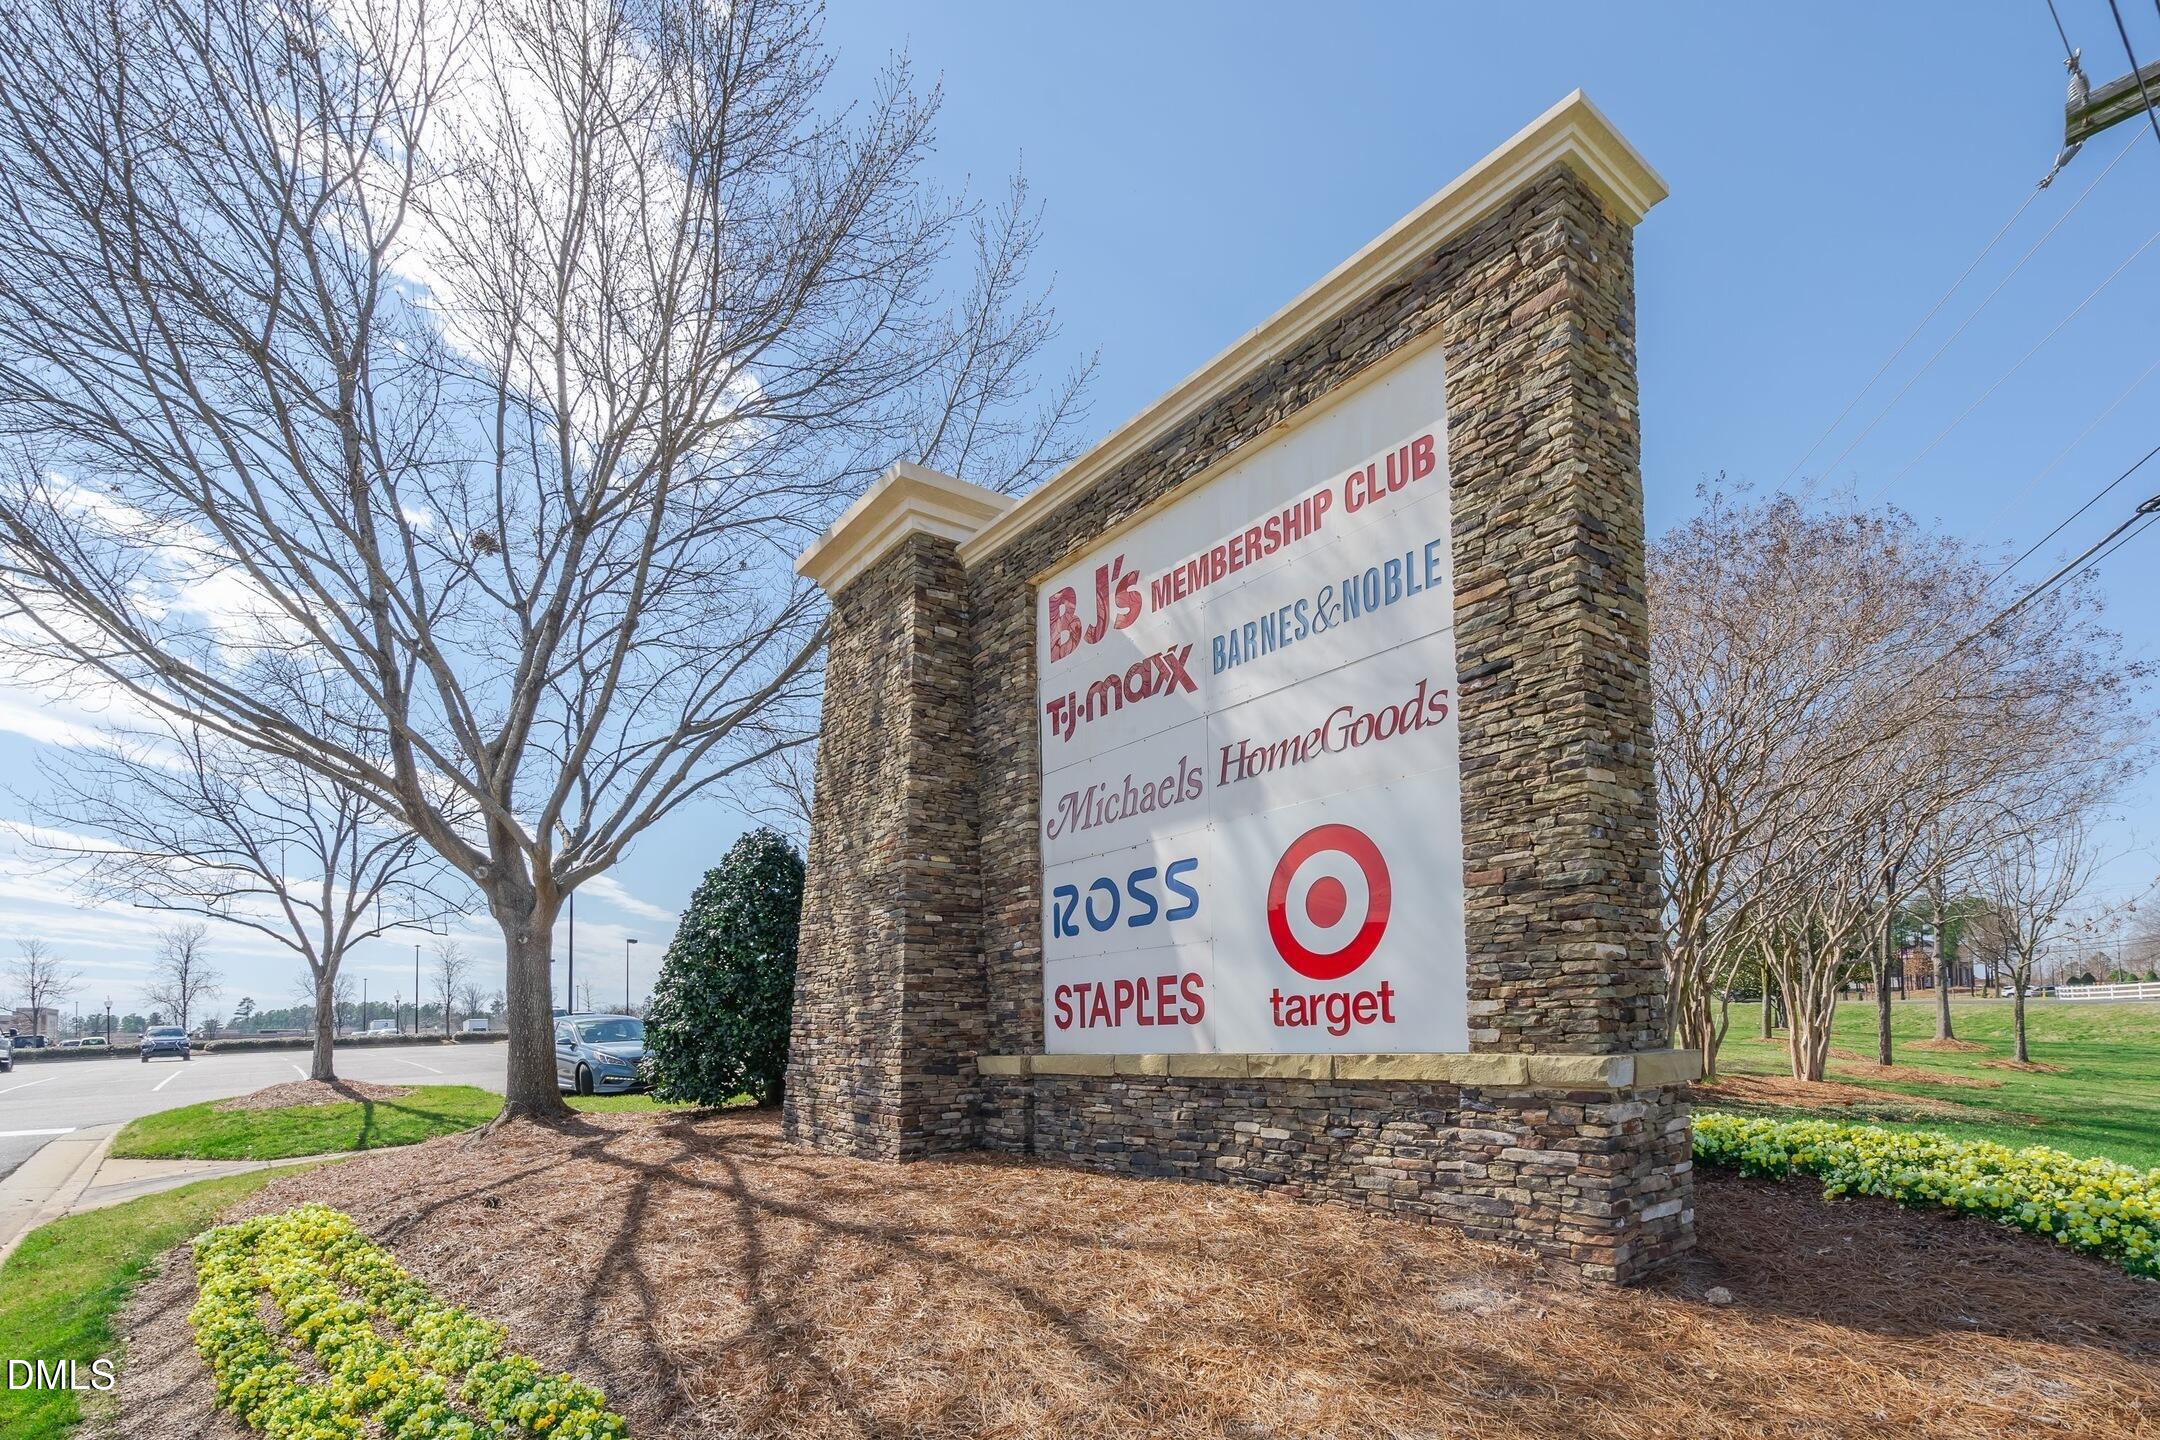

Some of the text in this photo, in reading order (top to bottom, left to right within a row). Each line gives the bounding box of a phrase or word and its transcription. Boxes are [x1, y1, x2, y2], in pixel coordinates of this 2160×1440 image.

[1049, 434, 1436, 663] BJ's MEMBERSHIP CLUB
[1217, 677, 1449, 788] HomeGoods
[1047, 756, 1204, 840] Michaels
[1053, 858, 1200, 938] ROSS
[1054, 972, 1205, 1030] STAPLES
[1270, 981, 1396, 1037] target
